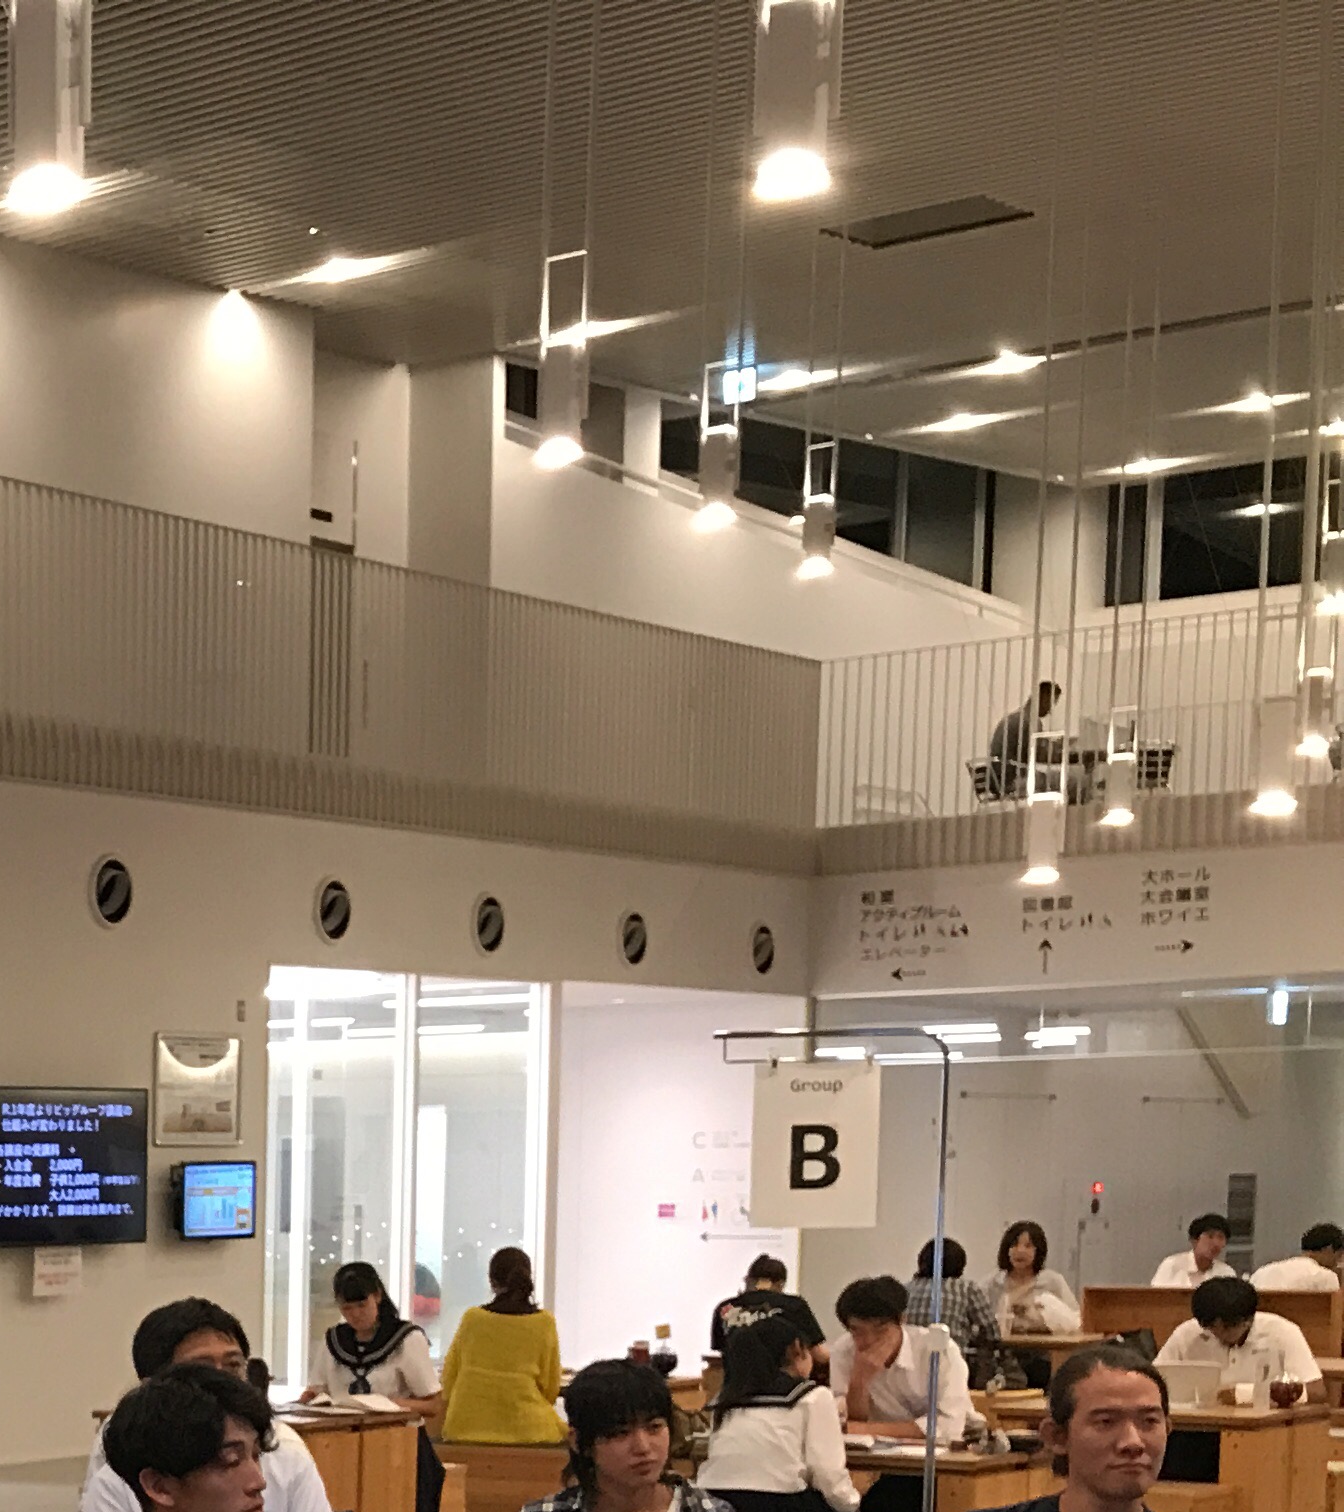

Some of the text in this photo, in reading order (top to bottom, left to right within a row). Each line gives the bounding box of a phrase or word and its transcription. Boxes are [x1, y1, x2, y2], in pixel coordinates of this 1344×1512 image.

[1141, 866, 1211, 886] 大ホール
[1022, 916, 1073, 934] トイレ
[1140, 905, 1210, 926] ホワイエ
[860, 923, 907, 943] トイレ
[790, 1077, 844, 1095] Group
[789, 1124, 842, 1191] B
